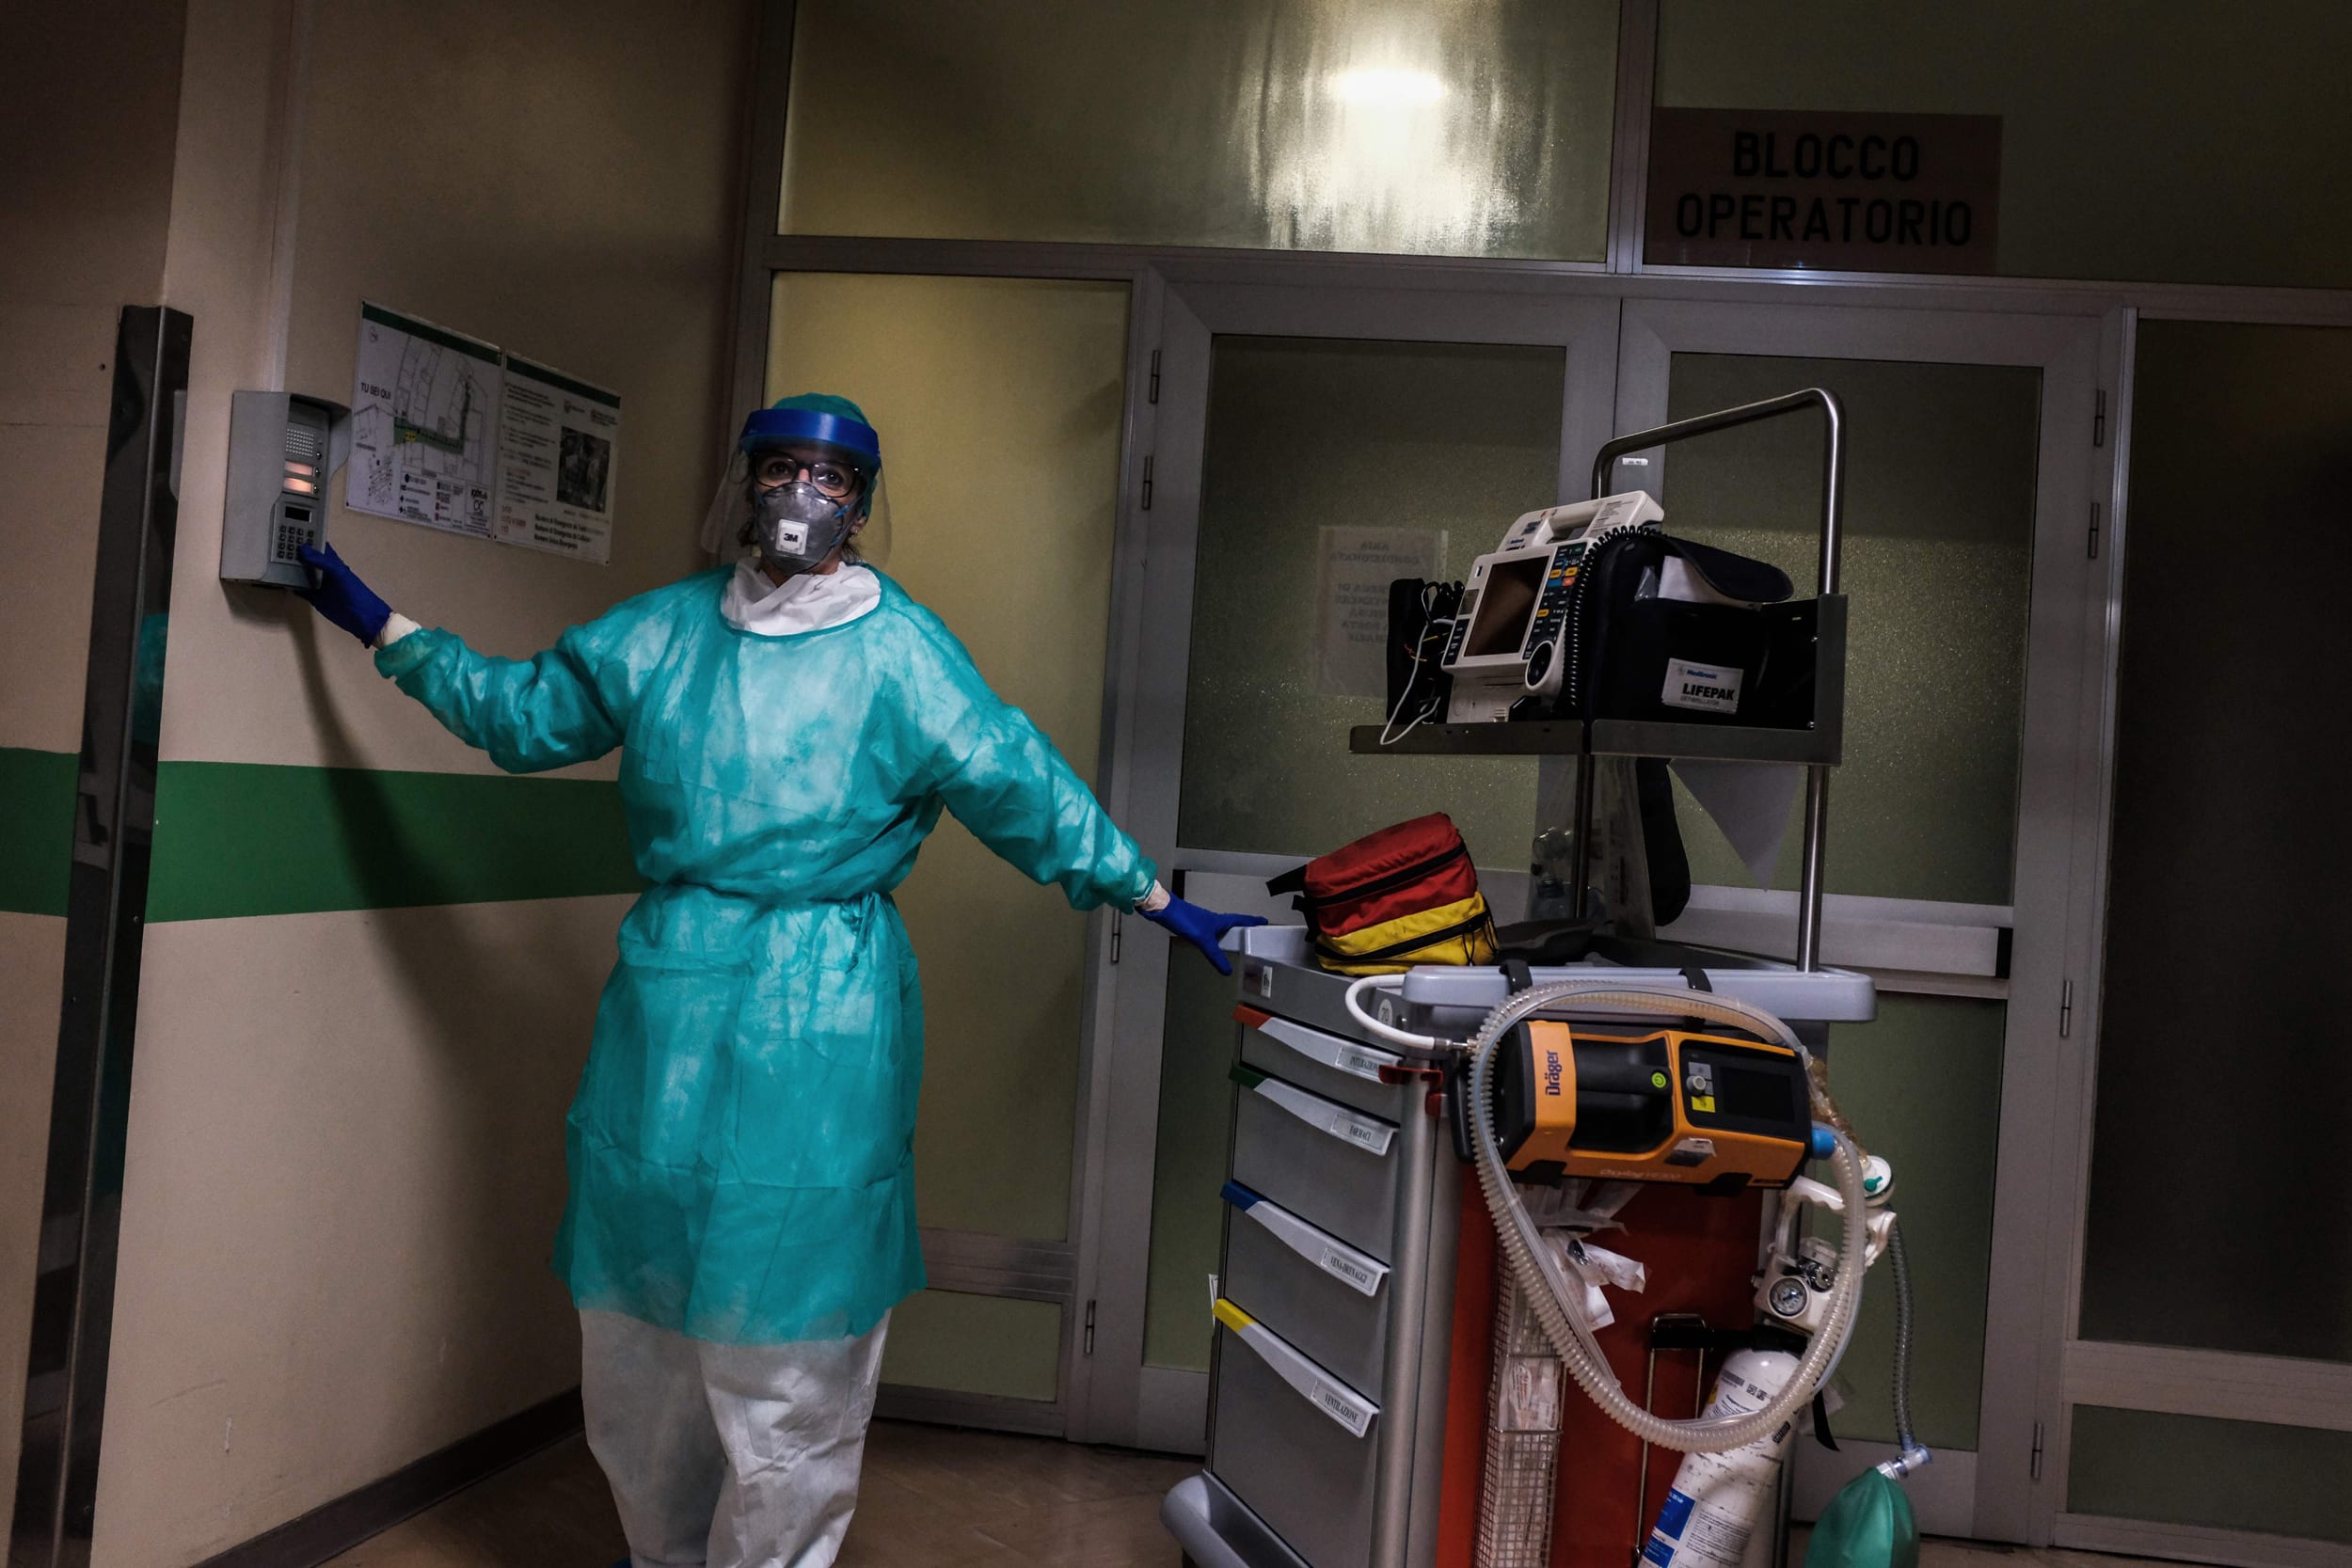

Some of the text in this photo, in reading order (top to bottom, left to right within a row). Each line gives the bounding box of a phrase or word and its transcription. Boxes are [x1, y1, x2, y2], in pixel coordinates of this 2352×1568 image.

[1734, 132, 1919, 181] BLOCCO
[1677, 194, 1972, 246] OPERATORIO
[361, 382, 369, 393] TU
[784, 532, 798, 543] 3M
[1682, 683, 1735, 701] LIFEPAK
[1544, 1050, 1563, 1096] Dräger
